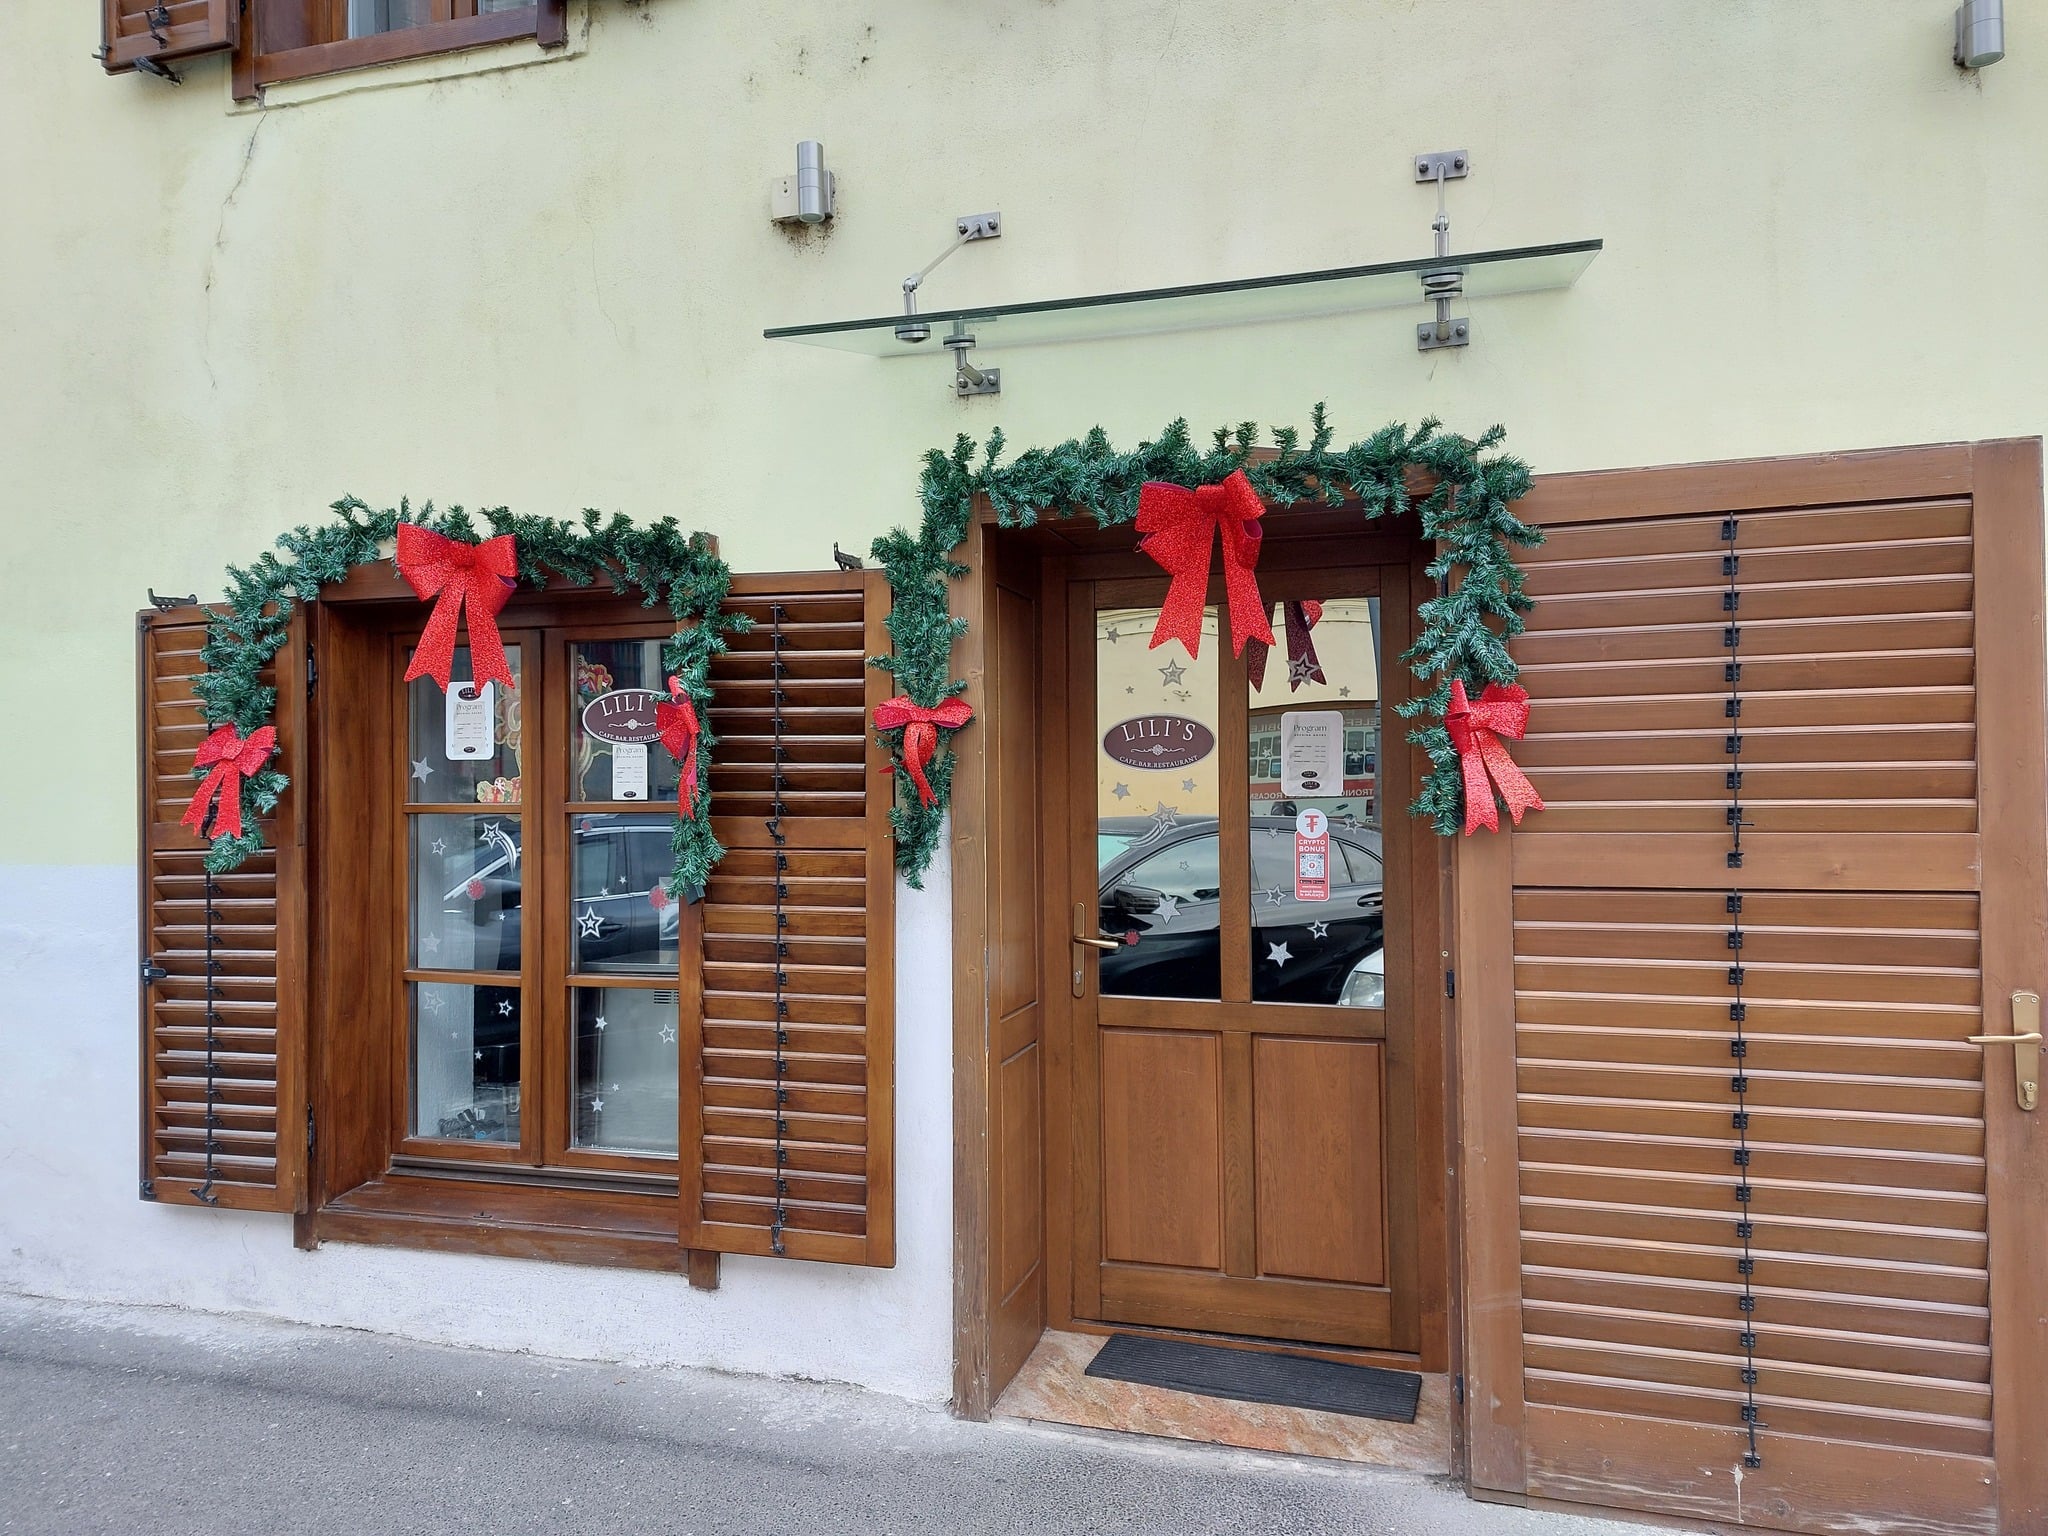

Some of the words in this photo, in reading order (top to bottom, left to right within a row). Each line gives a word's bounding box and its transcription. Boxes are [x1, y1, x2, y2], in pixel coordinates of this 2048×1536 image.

[600, 694, 659, 717] LILI'
[1120, 719, 1196, 742] LILI'S
[1293, 724, 1327, 734] Program
[1298, 845, 1326, 853] BONUS
